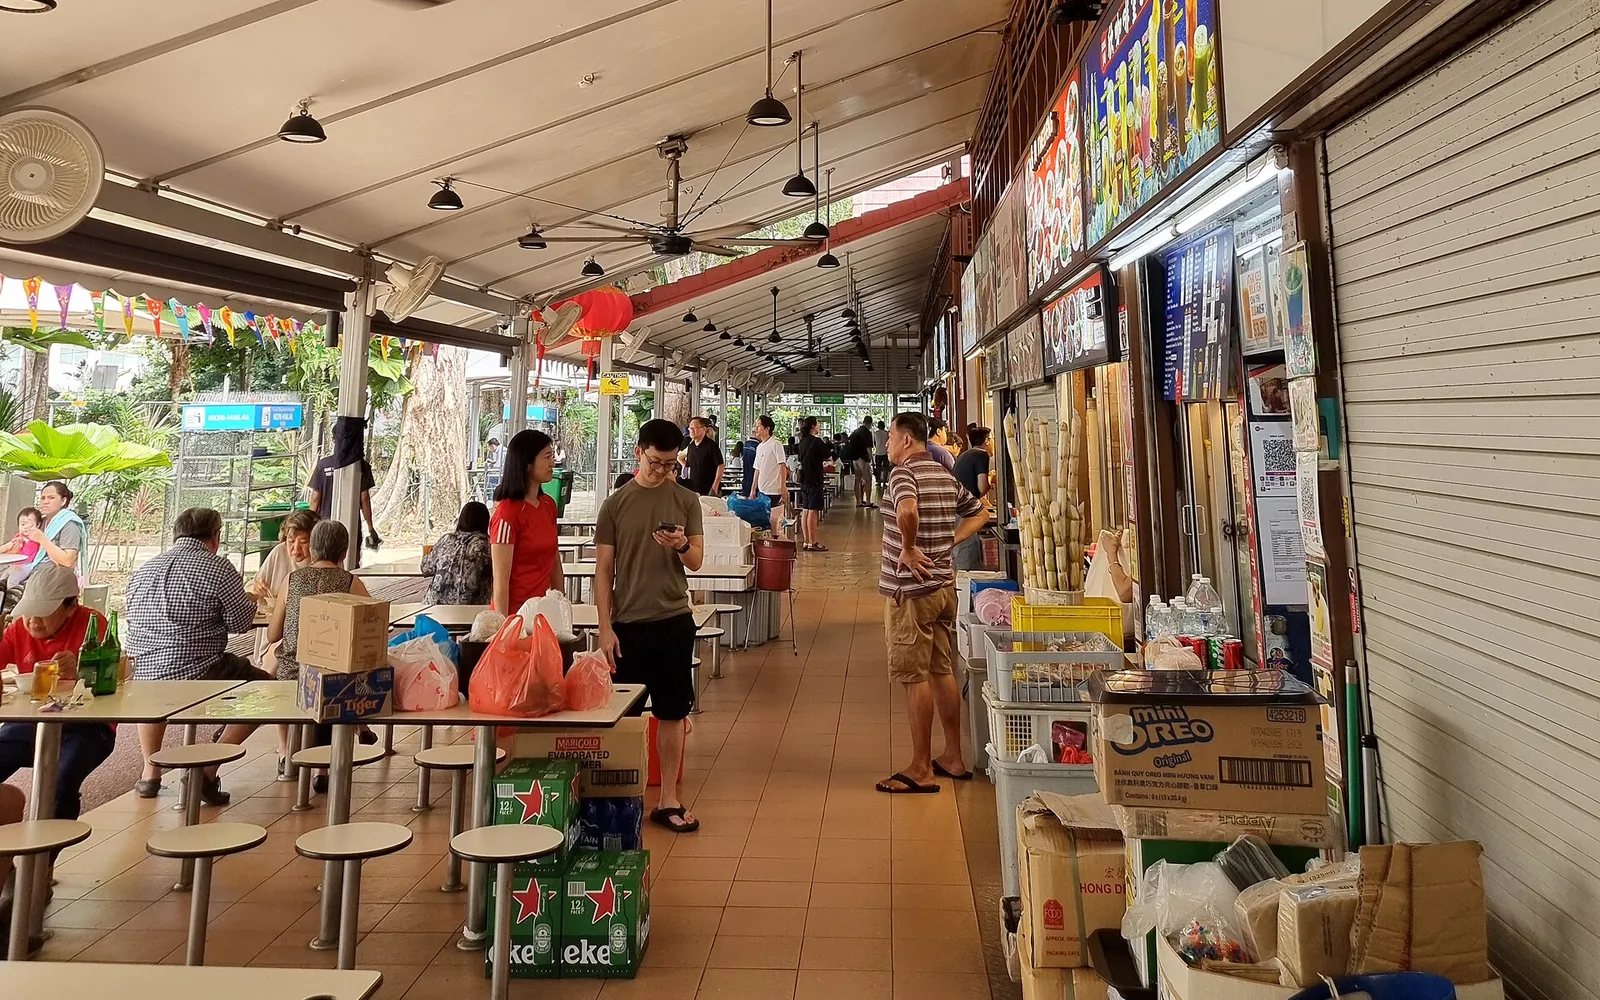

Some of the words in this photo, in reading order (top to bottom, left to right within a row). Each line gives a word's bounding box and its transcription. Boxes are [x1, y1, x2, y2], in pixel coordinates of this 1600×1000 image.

[208, 414, 250, 422] NON-HALAL
[344, 697, 379, 715] Tiger
[1132, 705, 1186, 722] mini
[1269, 709, 1304, 722] 4253218
[557, 738, 599, 749] MARIGOLD
[548, 750, 610, 759] EVAPORATED
[1154, 750, 1191, 768] Original
[499, 801, 510, 811] 12
[1218, 814, 1277, 840] APPLE
[1080, 883, 1111, 894] HONG
[570, 900, 581, 910] 12
